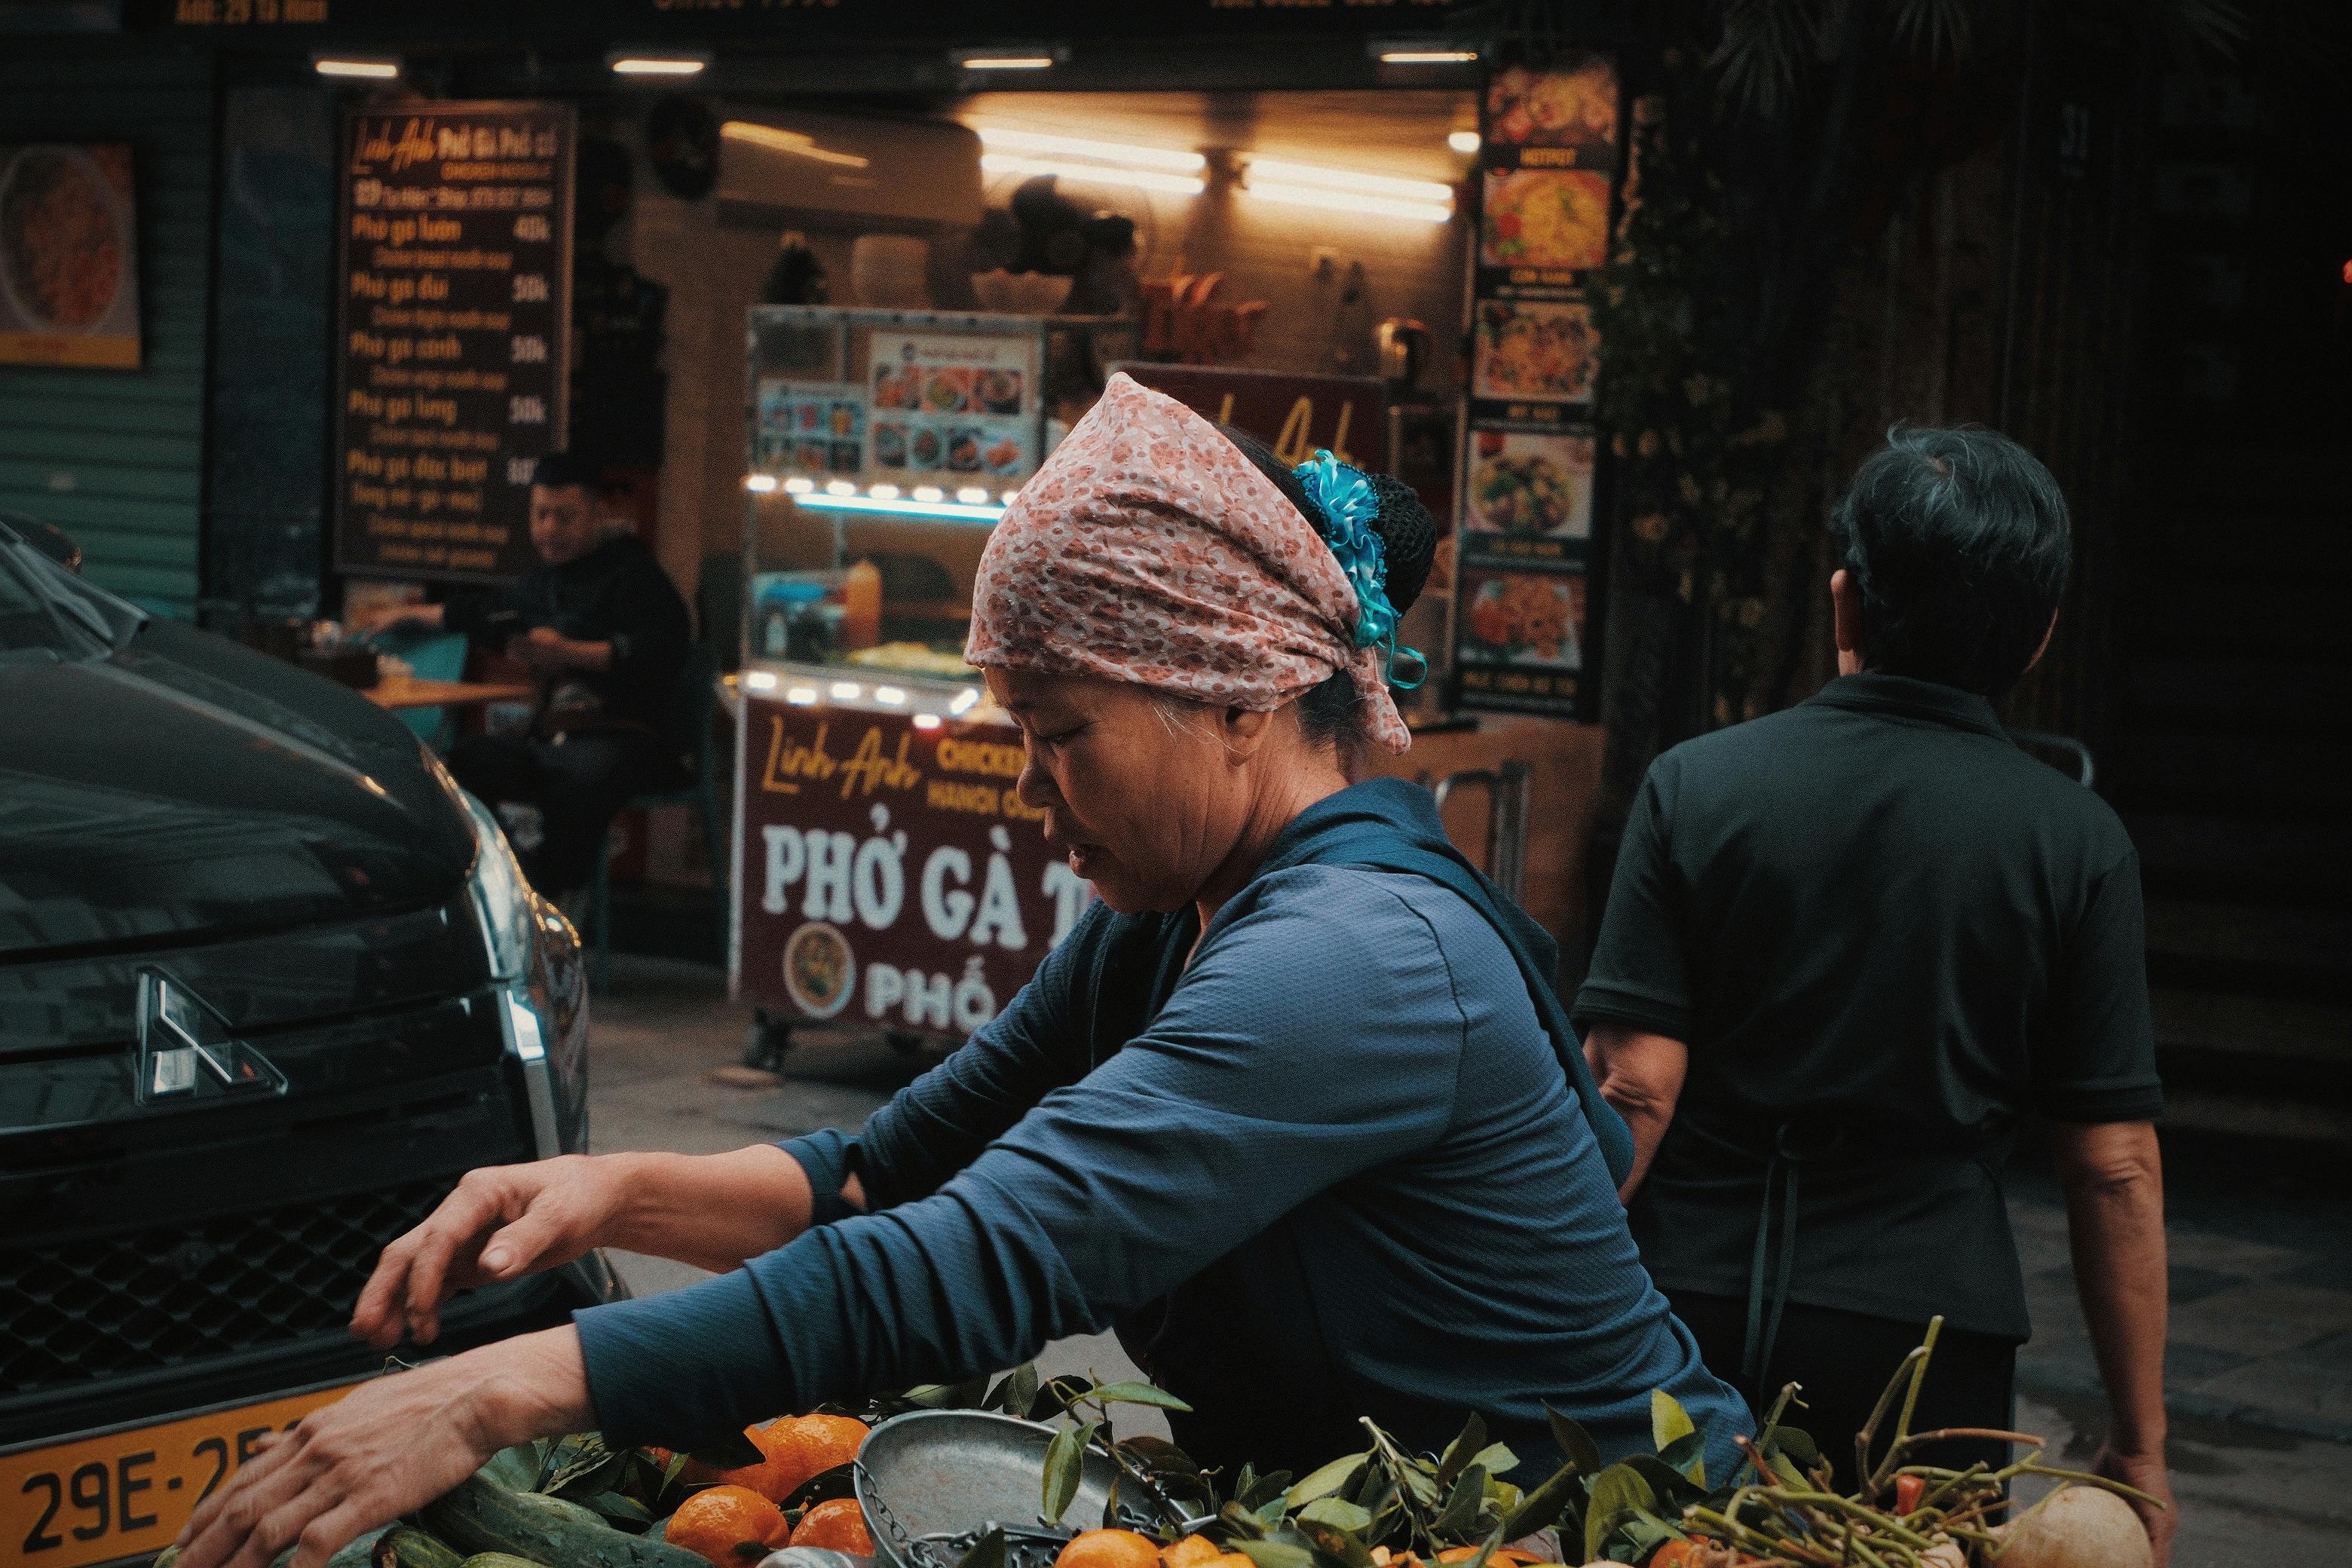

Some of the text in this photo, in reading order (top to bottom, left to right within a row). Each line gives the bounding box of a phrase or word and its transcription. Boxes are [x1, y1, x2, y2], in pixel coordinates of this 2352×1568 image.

[762, 716, 923, 801] Linh Anh
[762, 801, 908, 930] PHỞ
[921, 825, 1028, 951] GÀ
